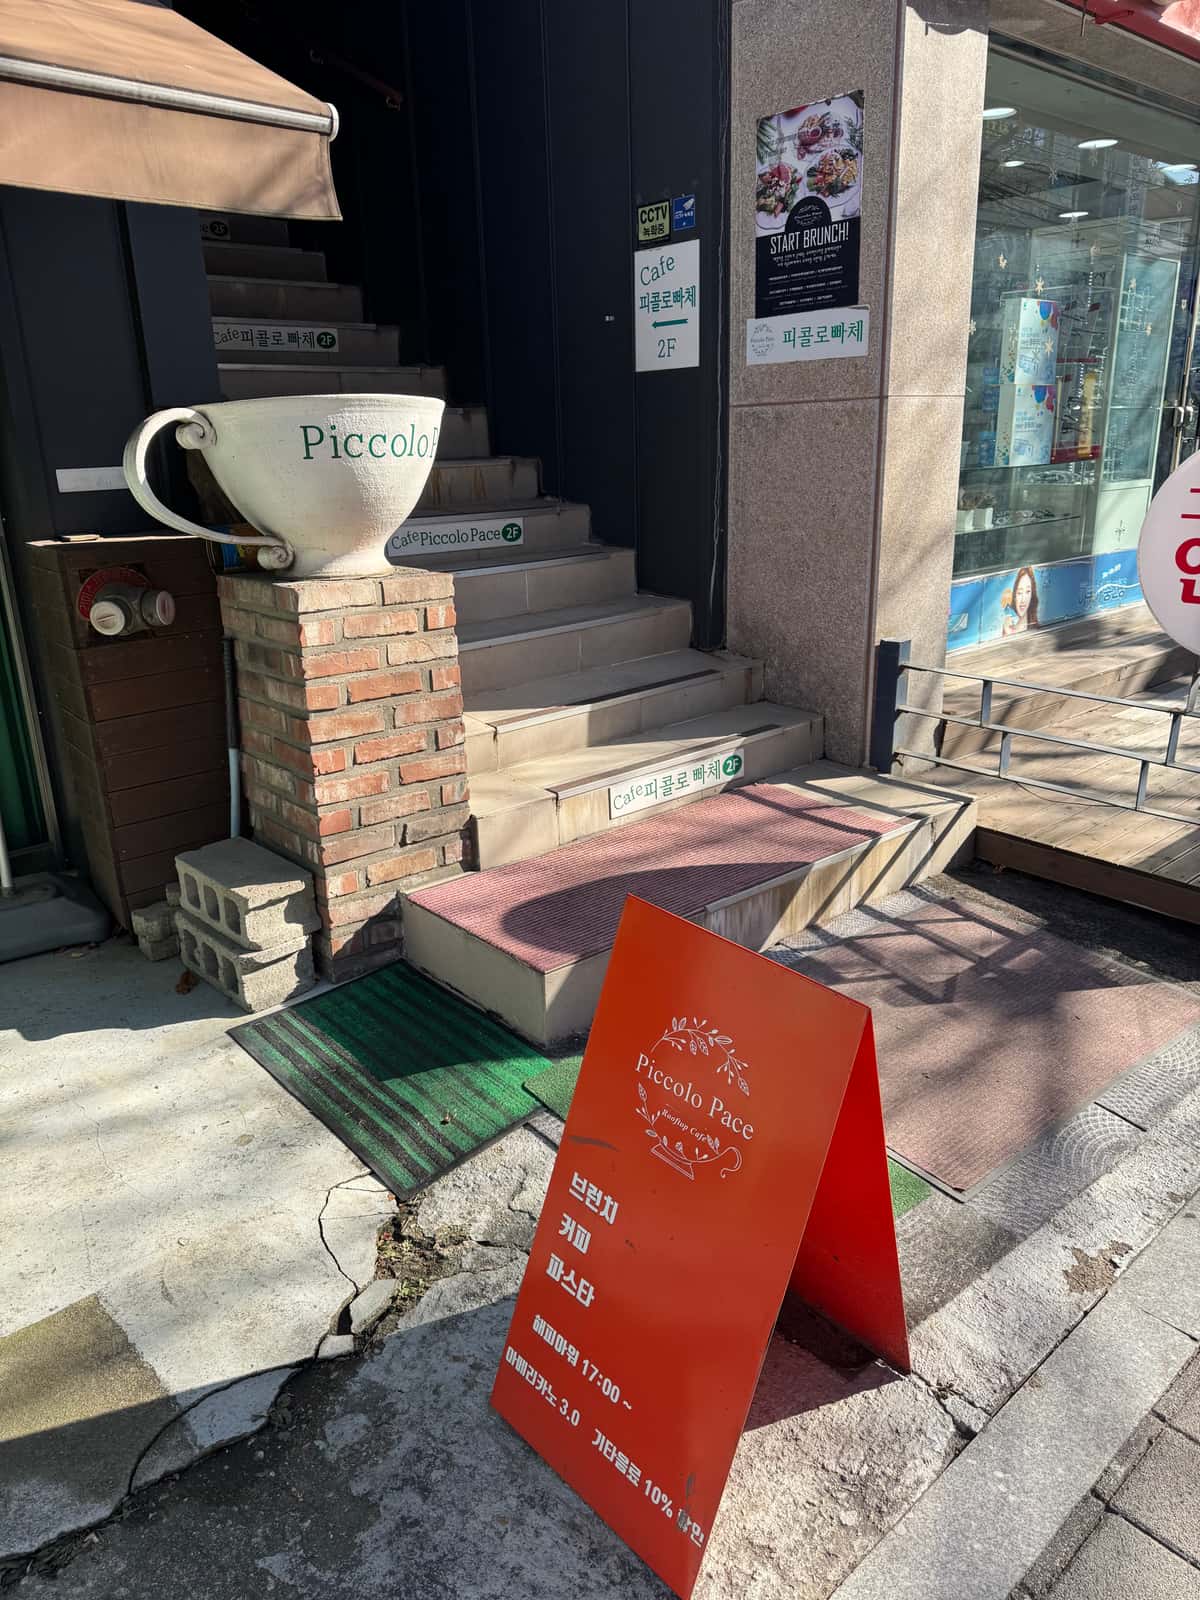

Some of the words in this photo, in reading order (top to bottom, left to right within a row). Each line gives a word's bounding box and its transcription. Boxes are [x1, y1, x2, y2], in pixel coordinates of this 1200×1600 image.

[641, 204, 668, 224] CCTV
[770, 231, 801, 255] START
[803, 221, 849, 249] BRUNCH!
[640, 255, 676, 286] Cafe
[639, 285, 697, 314] 피콜로빠체
[657, 337, 677, 359] 2F
[782, 319, 864, 350] 피콜로빠체
[299, 423, 429, 460] Piccolo
[391, 530, 420, 550] Cafe
[420, 528, 470, 547] Piccolo
[470, 527, 501, 542] Pace
[506, 526, 519, 539] 2F
[725, 757, 740, 773] 2F
[635, 1052, 703, 1110] Piccolo
[708, 1095, 754, 1140] Pace
[661, 1108, 690, 1132] Rooftop
[568, 1171, 619, 1225] 브런치
[558, 1212, 592, 1254] 커피
[545, 1252, 595, 1308] 파스타
[532, 1314, 580, 1367] 해피아워
[582, 1359, 621, 1404] 17:00
[505, 1345, 558, 1408] 아메리카노
[559, 1398, 581, 1427] 3.0
[591, 1428, 642, 1488] 기타음료
[644, 1479, 673, 1518] 10%
